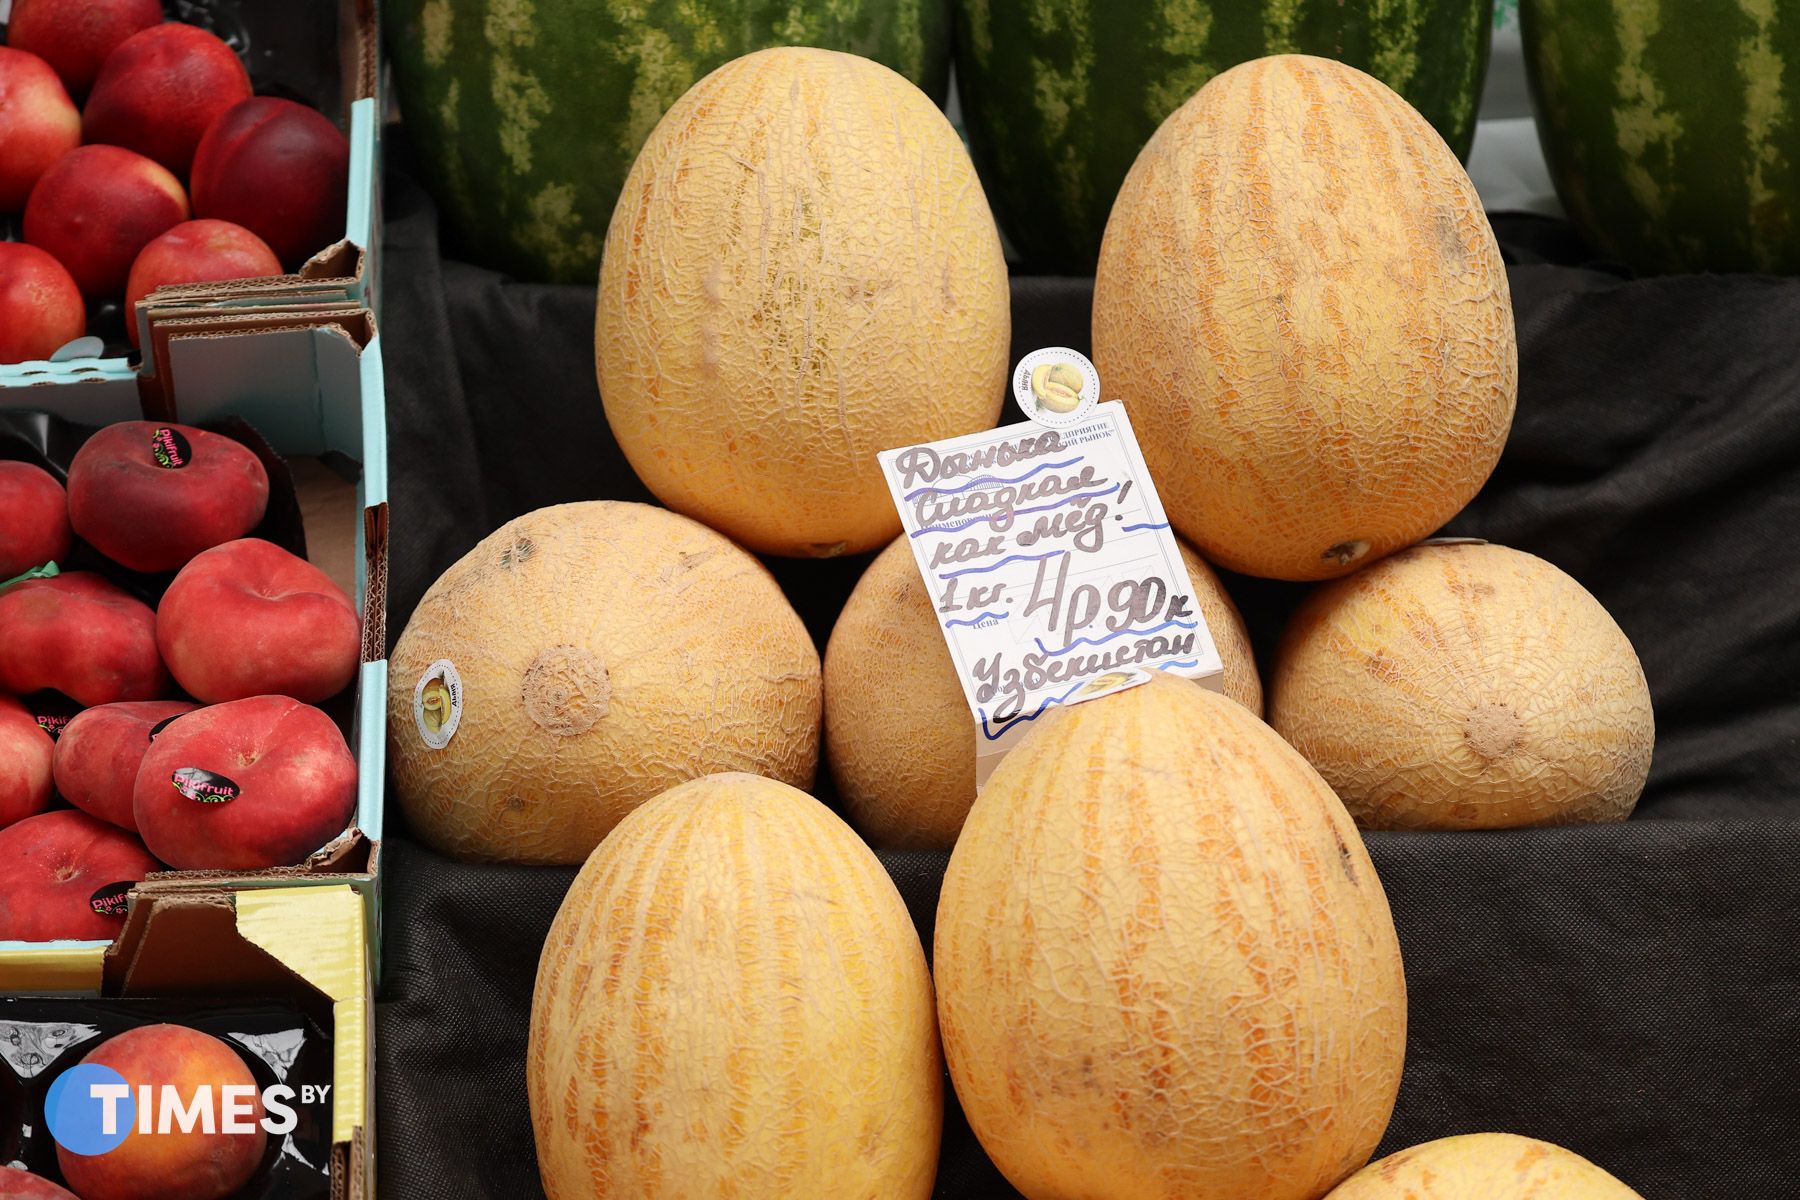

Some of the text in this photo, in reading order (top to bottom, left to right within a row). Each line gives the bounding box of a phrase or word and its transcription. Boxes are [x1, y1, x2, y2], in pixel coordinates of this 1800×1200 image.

[930, 535, 1007, 570] как
[174, 773, 234, 795] Pikifruit
[91, 893, 129, 909] Pikifr
